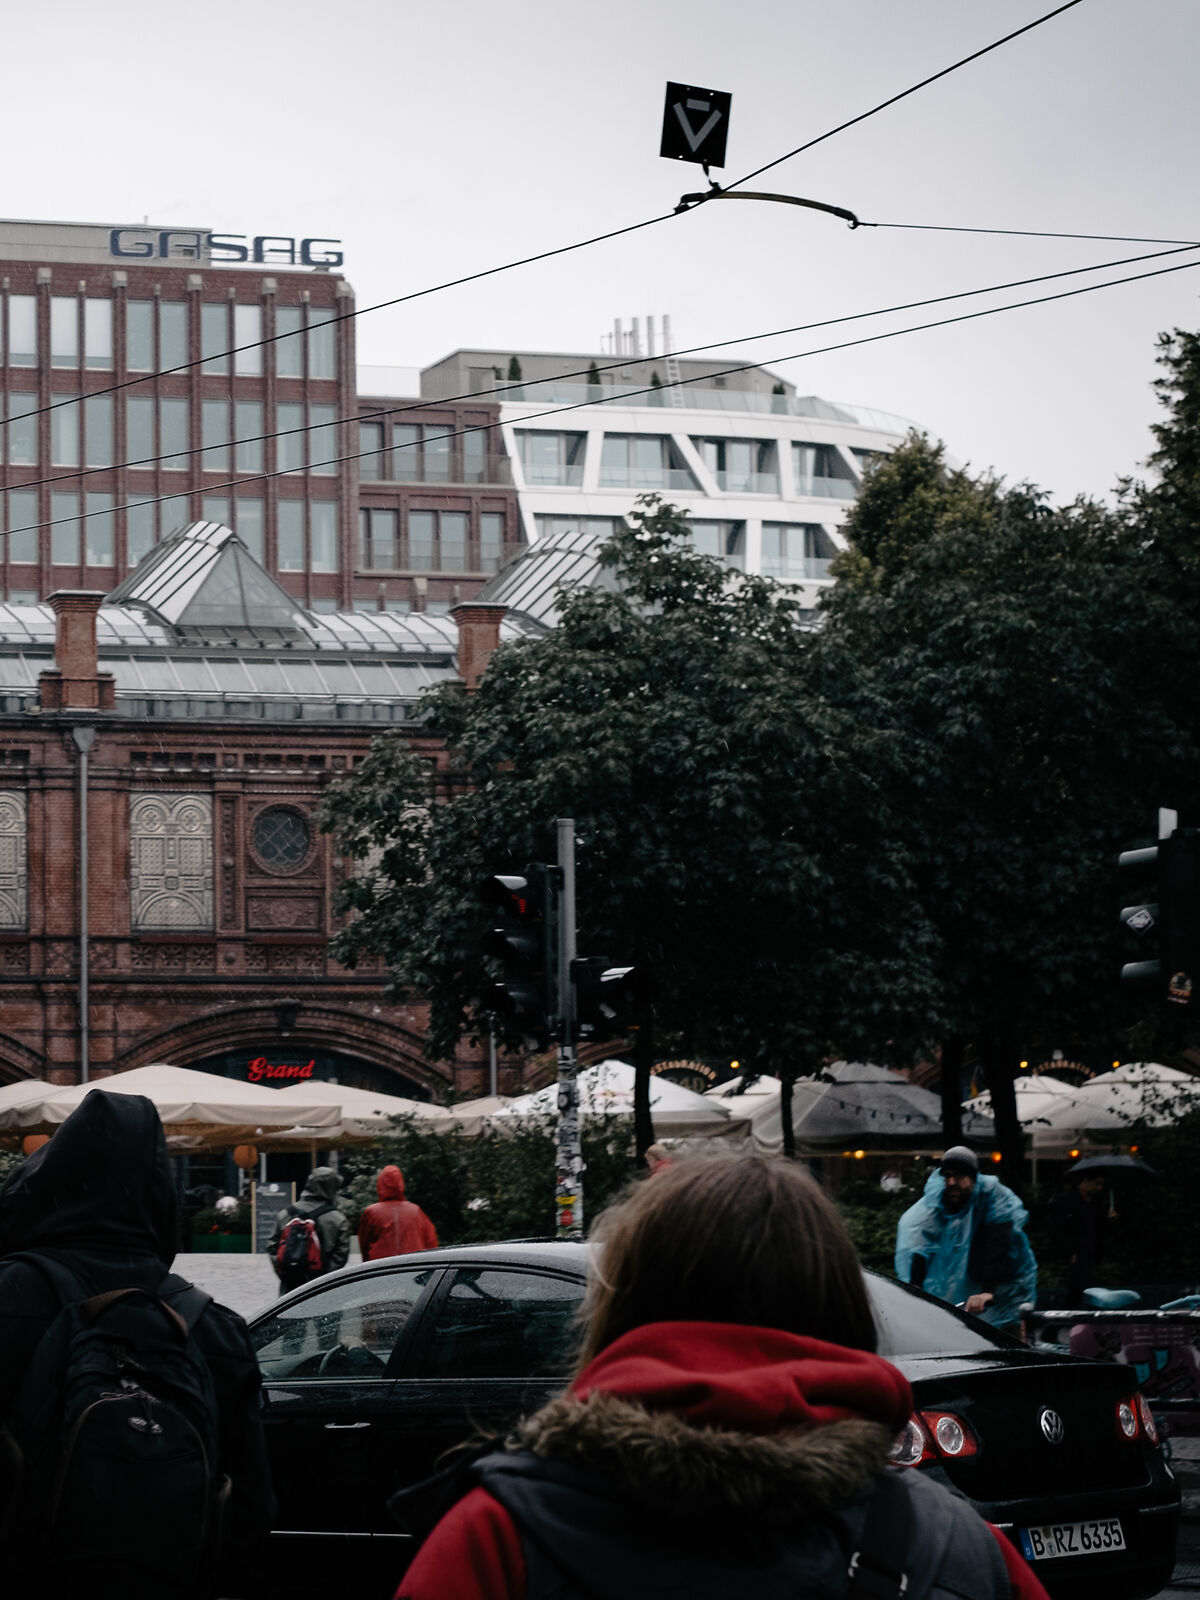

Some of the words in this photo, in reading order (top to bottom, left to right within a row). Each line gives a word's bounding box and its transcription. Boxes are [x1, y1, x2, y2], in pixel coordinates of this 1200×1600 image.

[110, 229, 343, 267] GASAG
[248, 1056, 316, 1082] Grand
[1030, 1529, 1045, 1555] B
[1053, 1526, 1079, 1553] RZ
[1080, 1520, 1122, 1550] 6335
